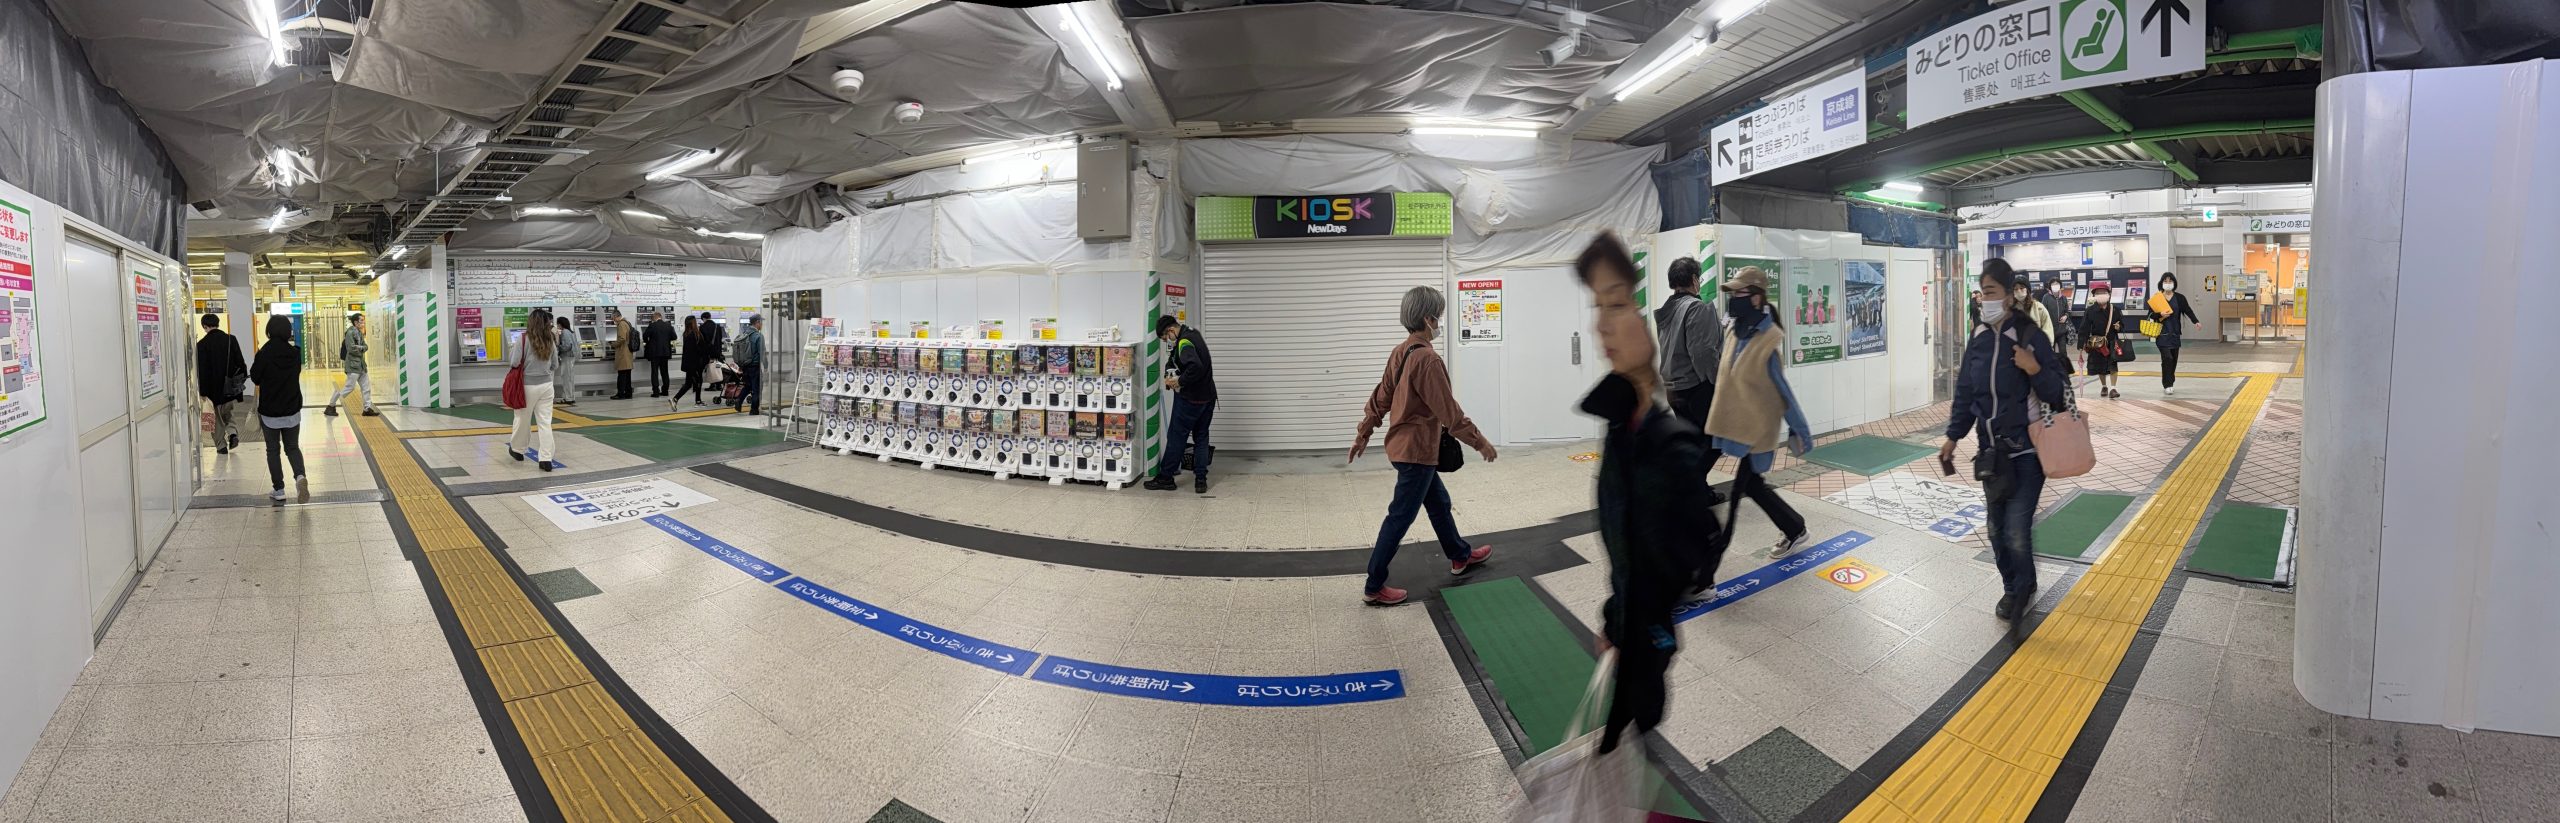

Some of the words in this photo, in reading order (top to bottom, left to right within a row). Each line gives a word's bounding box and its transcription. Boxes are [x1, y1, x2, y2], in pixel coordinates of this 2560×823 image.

[1915, 6, 2051, 75] みどりの窓口
[1958, 58, 2000, 83] Ticket
[2004, 48, 2051, 71] Office
[1964, 81, 1999, 104] 售票处
[2010, 71, 2052, 91] 매표소
[1754, 94, 1808, 128] きっぷうりば
[1826, 94, 1855, 116] 京成線
[1843, 111, 1856, 121] Line
[1755, 128, 1810, 158] 定期券うりば
[1276, 197, 1373, 222] KIOSK
[1307, 223, 1347, 234] NewDays
[2058, 224, 2099, 236] きっぷうりば
[2265, 220, 2310, 229] みどりの窓口
[593, 505, 660, 523] この先
[791, 582, 863, 616] 定期券うりば
[899, 624, 995, 659] きっぷうりば
[1051, 663, 1171, 693] 定期券うりば
[1237, 681, 1368, 698] きっぷうりば
